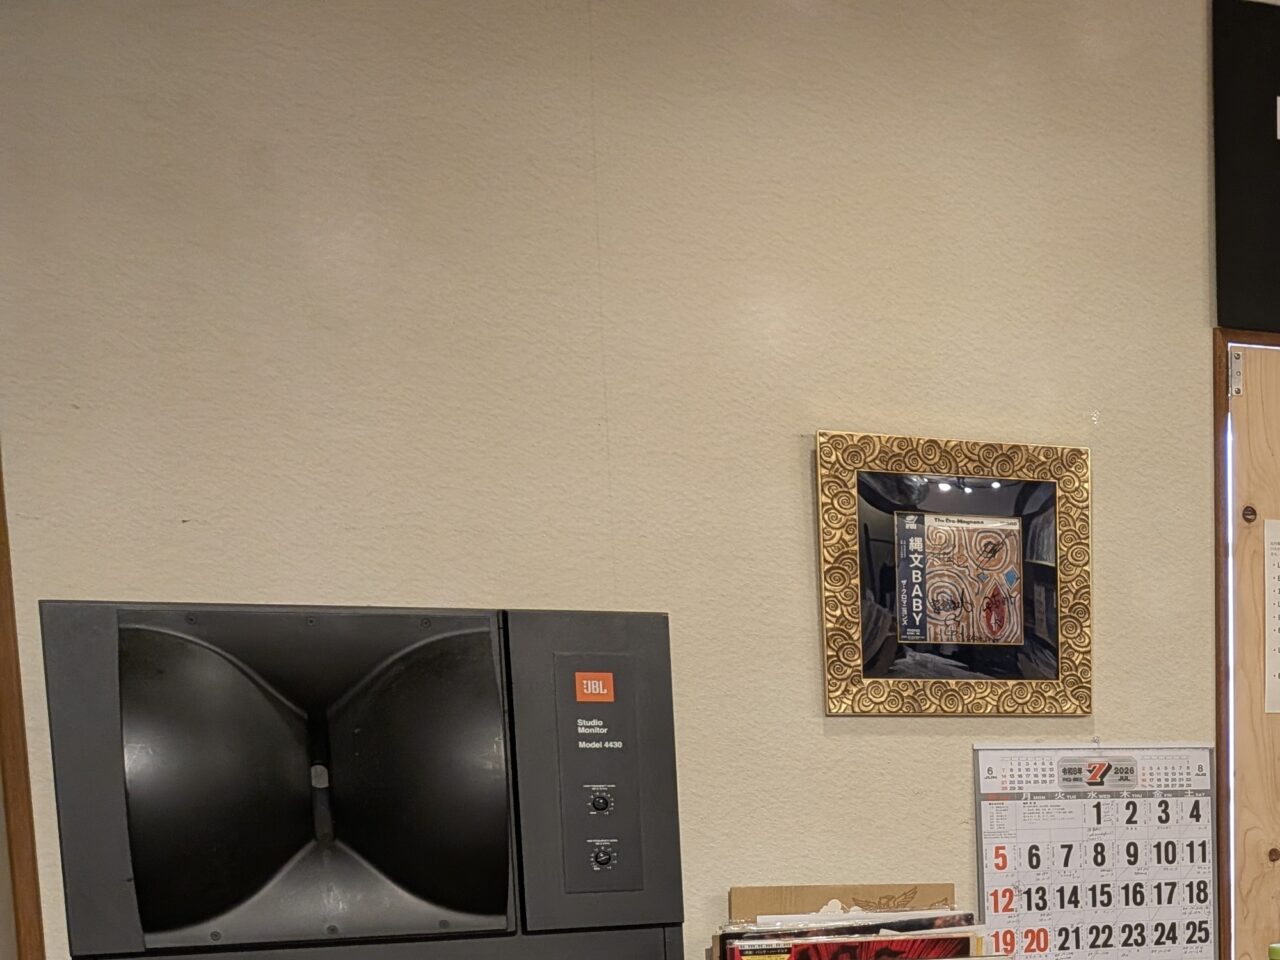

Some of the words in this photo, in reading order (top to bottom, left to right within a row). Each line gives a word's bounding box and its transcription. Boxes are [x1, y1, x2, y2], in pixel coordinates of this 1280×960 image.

[583, 680, 607, 694] JBL
[987, 767, 993, 775] 6
[1086, 761, 1112, 786] 7
[1114, 767, 1134, 775] 2026
[1197, 764, 1203, 773] 8
[1021, 792, 1030, 800] 月
[1055, 792, 1065, 800] 火
[1087, 791, 1098, 799] 水
[1120, 790, 1131, 798] 木
[1184, 789, 1195, 797] 土
[1093, 802, 1102, 825] 1
[1125, 800, 1138, 825] 2
[1157, 799, 1170, 824] 3
[1189, 799, 1201, 822] 4
[994, 845, 1008, 870] 5
[1028, 844, 1041, 870] 6
[1060, 844, 1073, 867] 7
[1093, 842, 1106, 867] 8
[1125, 841, 1138, 866] 9
[1153, 840, 1177, 864] 10
[1185, 839, 1207, 863] 11
[990, 887, 1015, 914] 12
[1023, 886, 1047, 911] 13
[1055, 884, 1079, 909] 14
[1088, 883, 1112, 907] 15
[1120, 882, 1145, 906] 16
[1153, 881, 1177, 905] 17
[1185, 880, 1209, 904] 18
[991, 929, 1015, 956] 19
[1023, 928, 1048, 953] 20
[1057, 927, 1081, 951] 21
[1088, 924, 1114, 949] 22
[1120, 923, 1145, 948] 23
[1153, 922, 1178, 946] 24
[1185, 920, 1210, 944] 25
